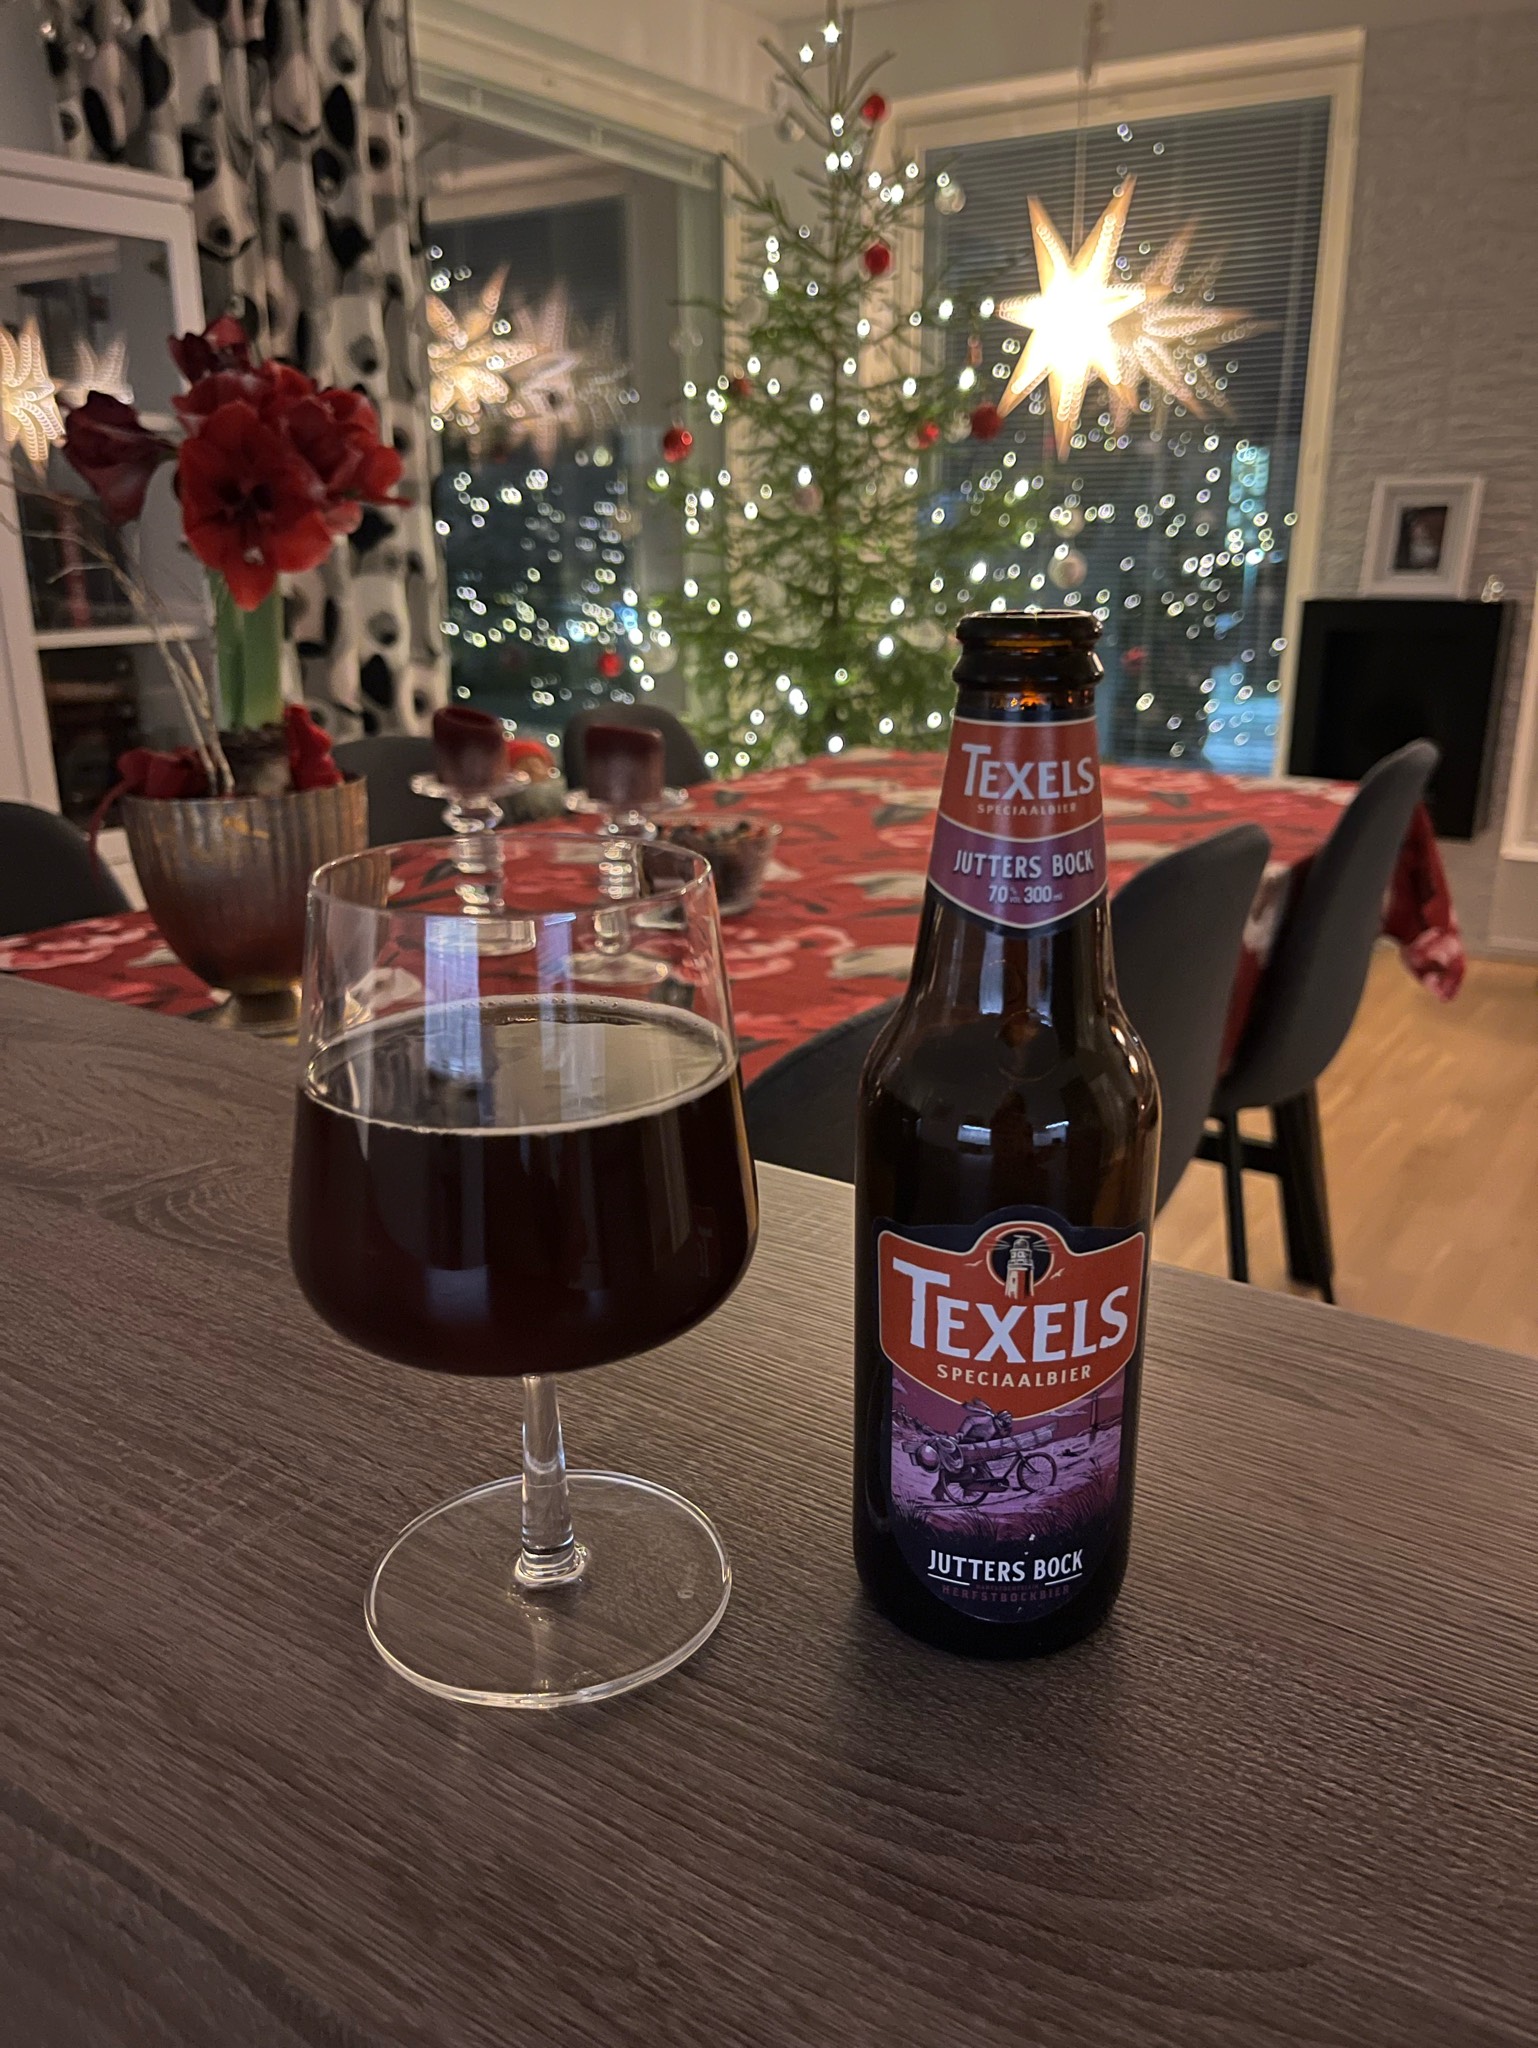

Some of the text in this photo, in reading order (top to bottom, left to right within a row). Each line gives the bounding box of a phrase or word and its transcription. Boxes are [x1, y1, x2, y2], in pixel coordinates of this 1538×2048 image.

[961, 743, 1095, 800] TEXELS
[977, 802, 1077, 816] SPECIAALBIER
[953, 849, 1094, 879] JUTTERS BOCK
[1023, 886, 1052, 904] 300
[892, 1256, 1129, 1363] TEXELS
[936, 1364, 1091, 1388] SPECIAALBIER
[927, 1549, 1083, 1582] JUTTERS BOCK
[942, 1584, 1070, 1603] HERFSTBOCKBIER
